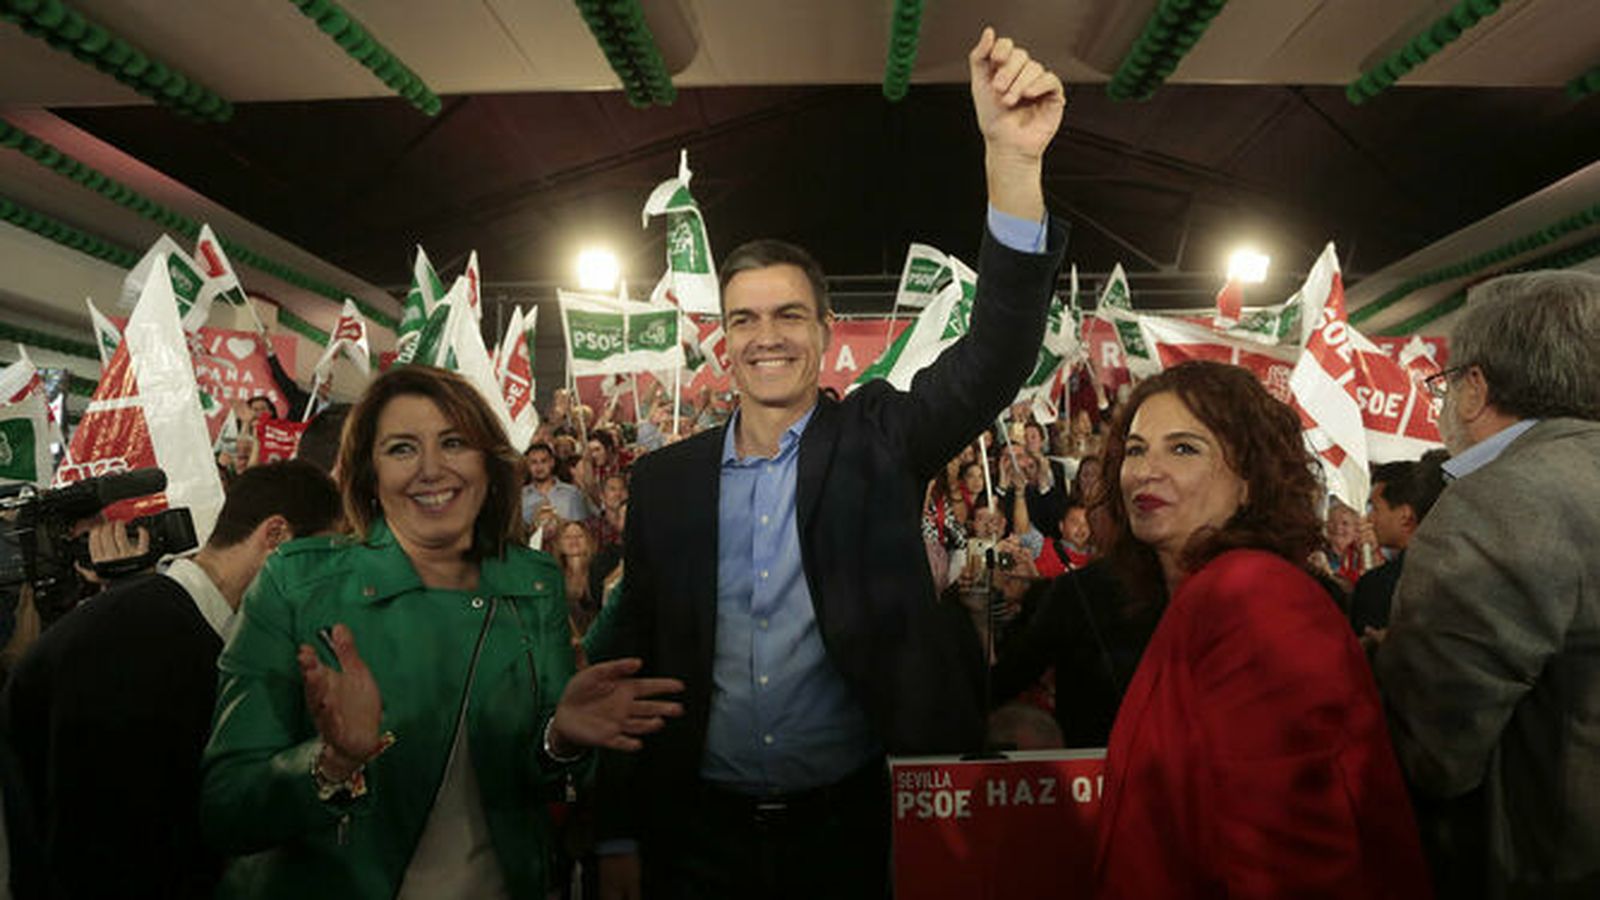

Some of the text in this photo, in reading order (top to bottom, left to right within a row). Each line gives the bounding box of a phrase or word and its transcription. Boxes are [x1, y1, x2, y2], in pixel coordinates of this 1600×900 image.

[573, 329, 623, 351] PSOE
[1356, 386, 1404, 418] SOE
[897, 771, 953, 789] SEVILLA
[987, 778, 1057, 807] HAZ
[897, 790, 972, 819] PSOE
